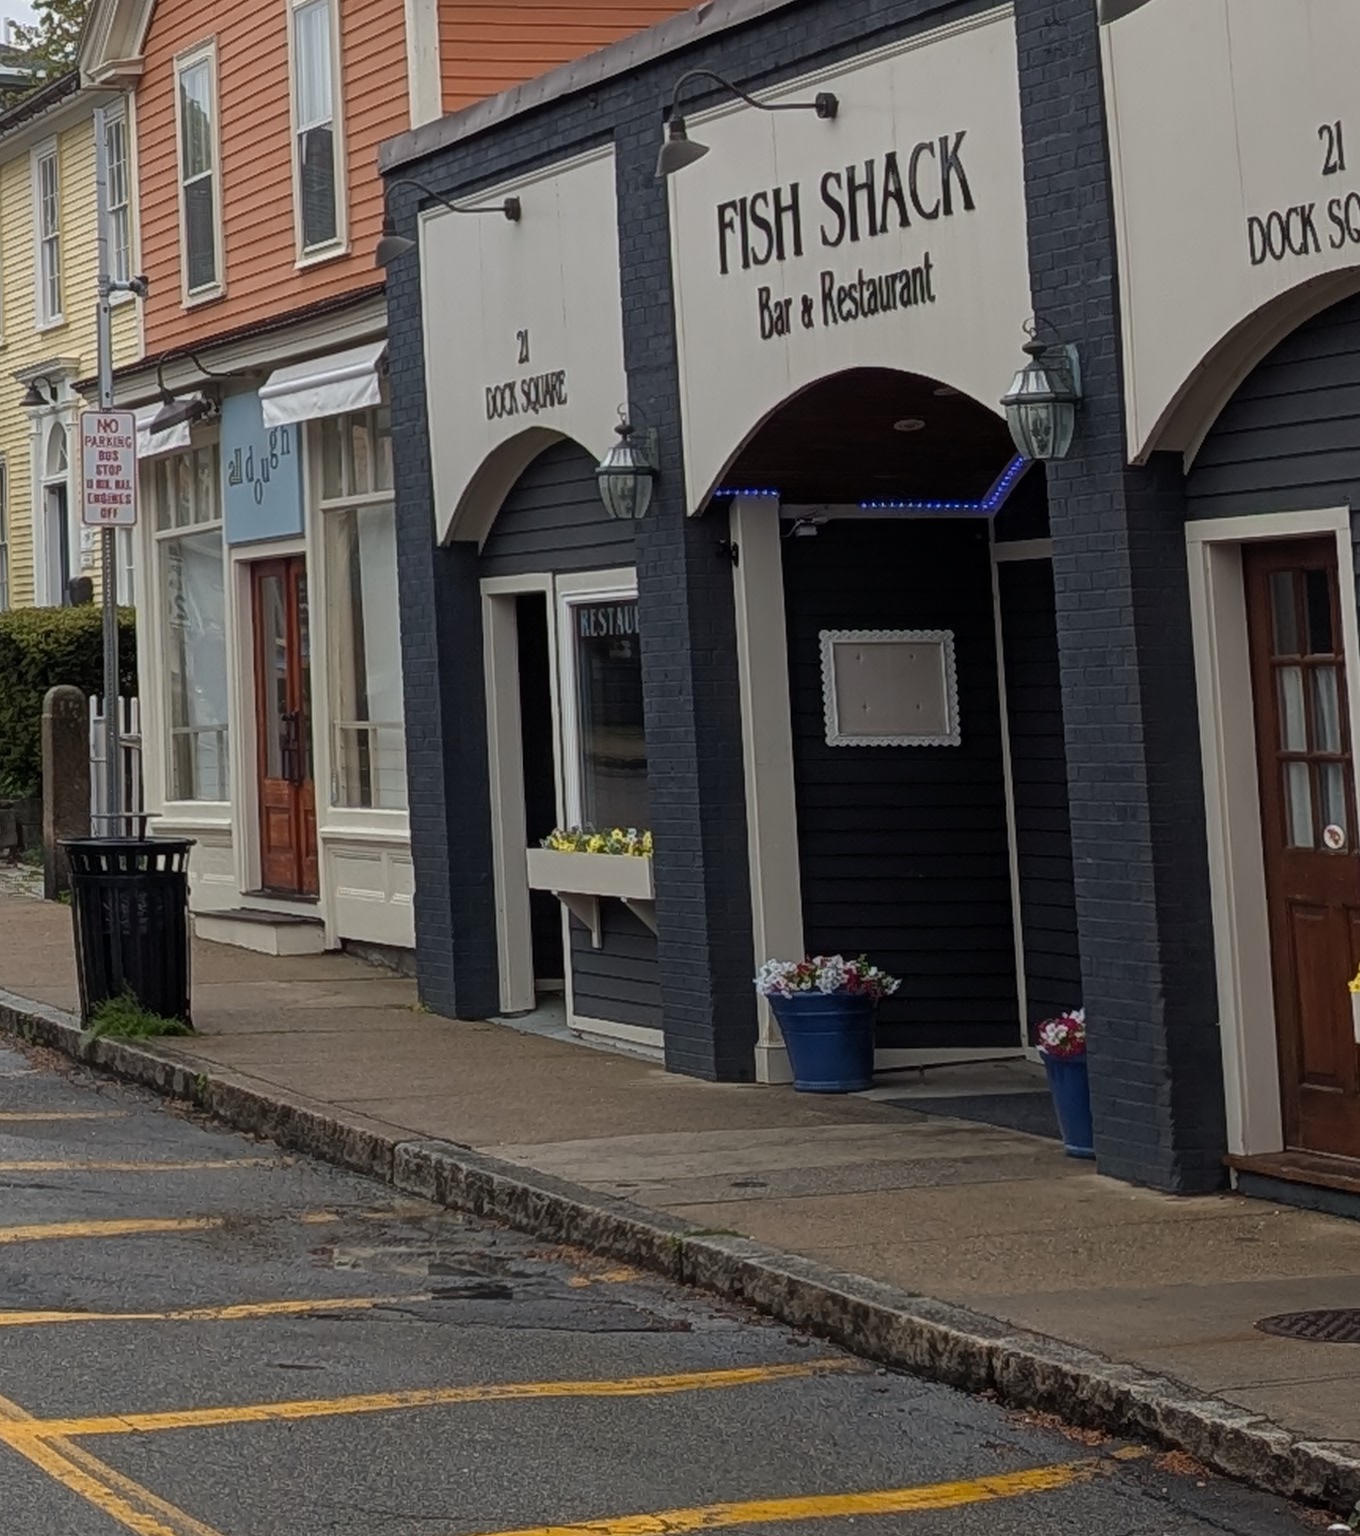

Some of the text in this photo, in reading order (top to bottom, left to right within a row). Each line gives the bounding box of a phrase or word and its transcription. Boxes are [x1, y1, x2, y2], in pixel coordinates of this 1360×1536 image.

[1318, 120, 1346, 176] 21
[717, 129, 976, 275] FISH SHACK
[1247, 203, 1321, 266] DOCK
[757, 251, 936, 340] Bar & Restaurant
[516, 329, 530, 365] 21
[486, 369, 568, 421] DOCK SQUARE
[84, 435, 133, 448] PARKING
[97, 418, 119, 434] NO
[95, 464, 122, 476] STOP
